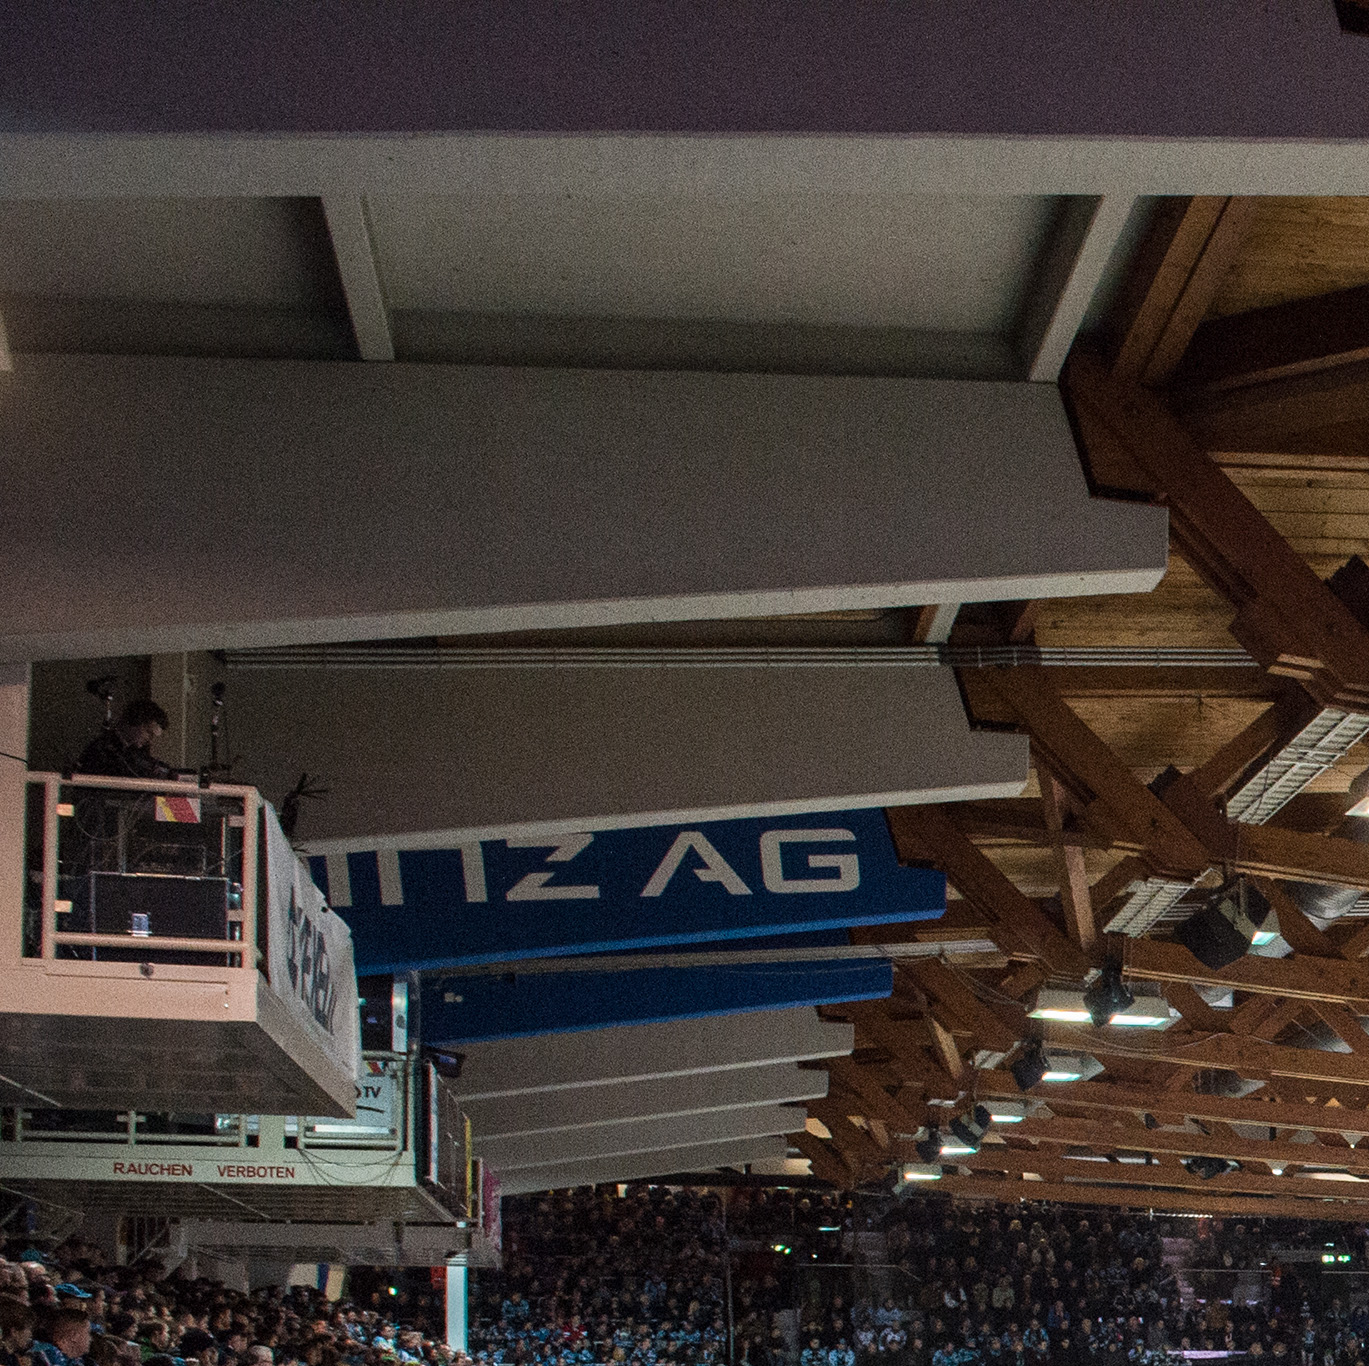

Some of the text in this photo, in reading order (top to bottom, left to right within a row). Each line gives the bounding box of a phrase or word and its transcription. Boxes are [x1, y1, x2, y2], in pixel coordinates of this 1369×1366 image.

[327, 828, 860, 906] INZ AG
[113, 1162, 296, 1180] RAUCHEN VERBOTEN
